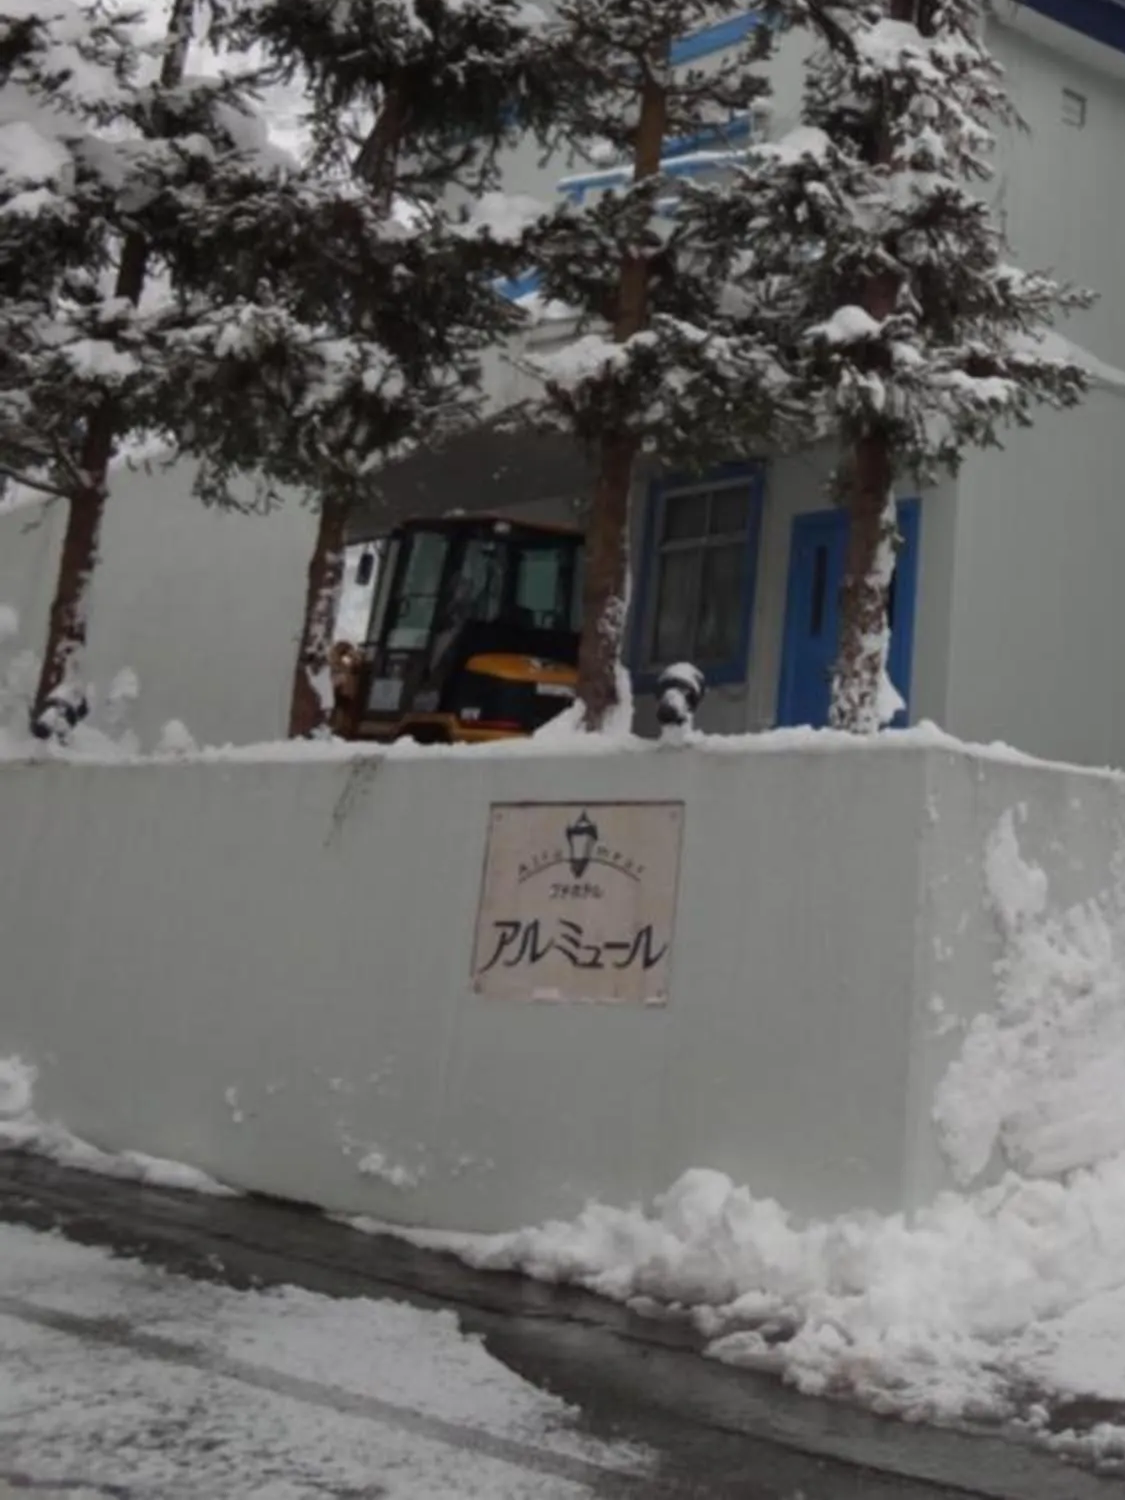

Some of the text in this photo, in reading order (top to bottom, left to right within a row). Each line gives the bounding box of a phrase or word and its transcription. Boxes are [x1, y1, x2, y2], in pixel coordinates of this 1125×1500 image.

[479, 918, 668, 975] アルミュール
